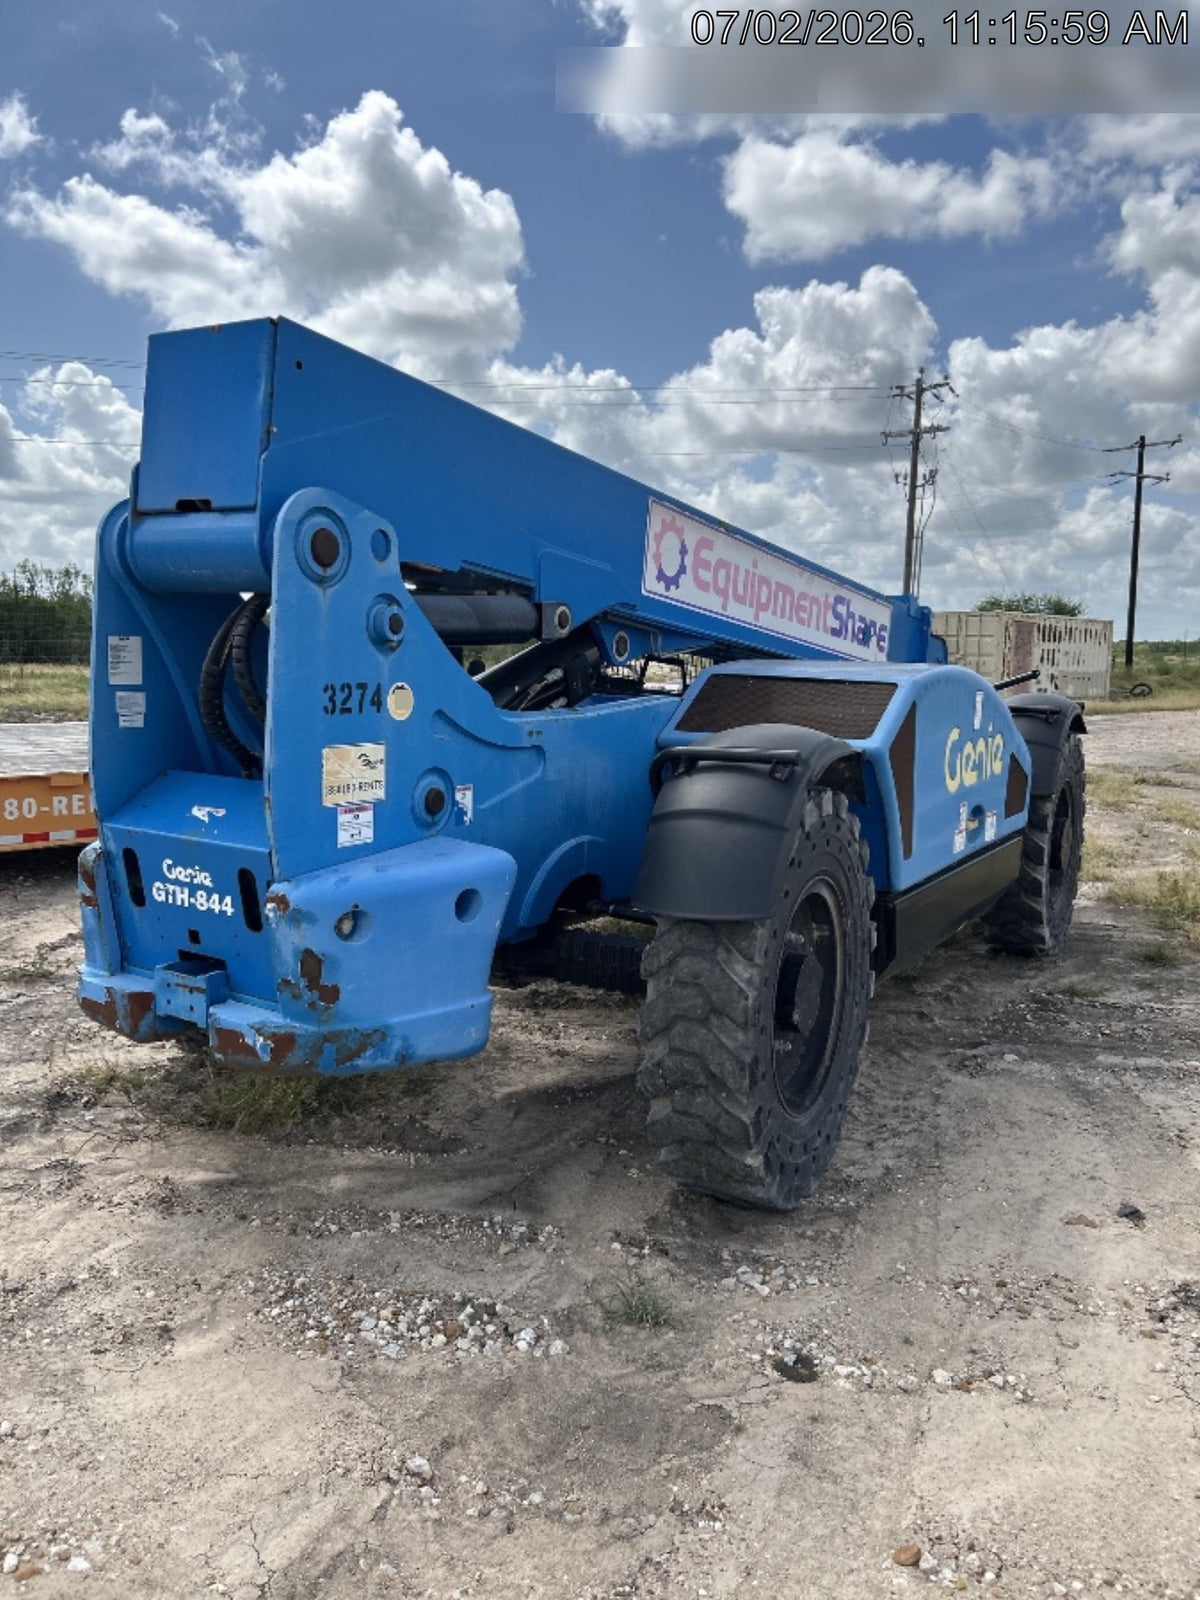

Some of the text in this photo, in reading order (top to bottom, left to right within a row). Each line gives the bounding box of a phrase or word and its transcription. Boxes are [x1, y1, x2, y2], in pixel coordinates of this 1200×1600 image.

[691, 535, 888, 653] EquipmentShare
[322, 682, 383, 716] 3274
[944, 721, 1005, 794] Genie
[3, 793, 95, 821] 80-RE
[162, 858, 214, 888] Genie
[151, 881, 236, 917] GTH-844
